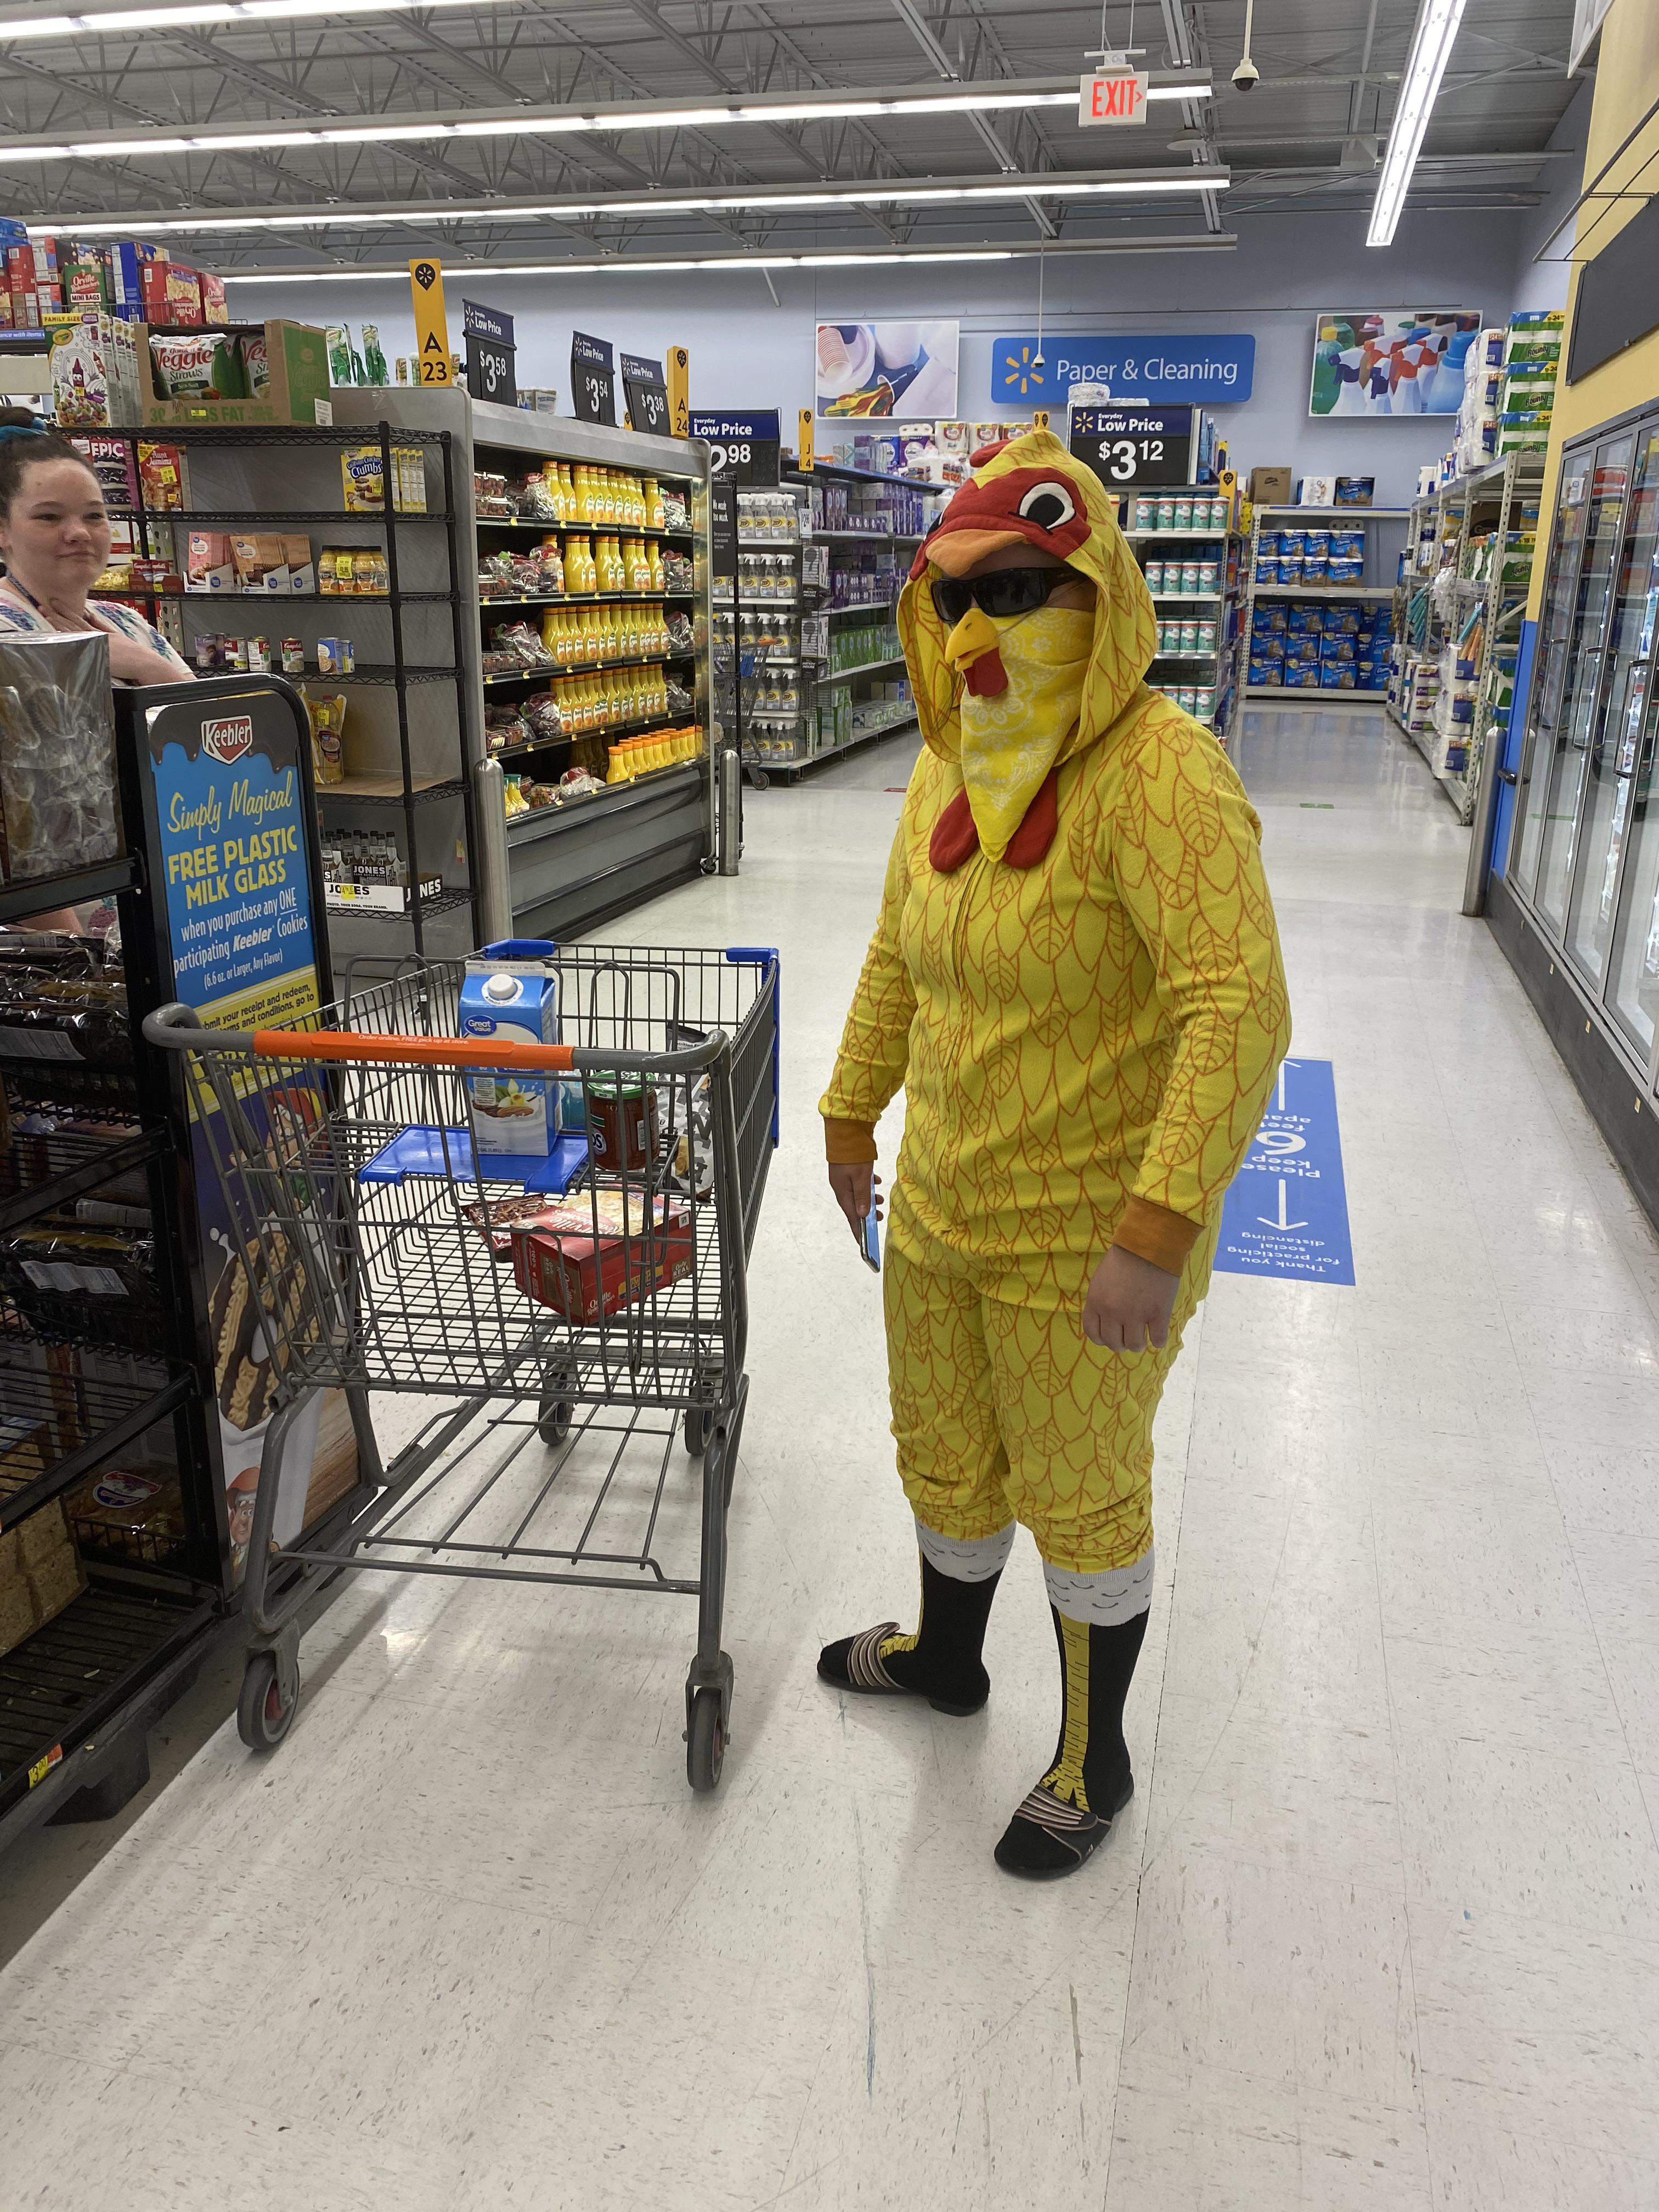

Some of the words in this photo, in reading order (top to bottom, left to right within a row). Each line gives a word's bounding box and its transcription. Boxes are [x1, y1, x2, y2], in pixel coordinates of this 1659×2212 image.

[1092, 80, 1137, 117] EXIT
[73, 274, 95, 285] Orville
[475, 316, 487, 330] Low
[488, 320, 502, 335] Price
[424, 331, 443, 353] A
[583, 345, 592, 358] Low
[592, 348, 604, 362] Price
[1527, 346, 1549, 357] Bounty
[155, 347, 215, 373] Veggie
[170, 369, 203, 382] Straws
[422, 361, 447, 381] 23
[631, 365, 642, 376] Low
[641, 368, 653, 379] Price
[1057, 360, 1117, 383] Paper
[1122, 360, 1138, 380] &
[1144, 358, 1238, 385] Cleaning
[678, 397, 686, 413] A
[1526, 395, 1547, 407] Bounty
[222, 407, 245, 422] FAT
[676, 417, 689, 432] 24
[693, 424, 719, 436] Low
[721, 422, 753, 436] Price
[1098, 421, 1126, 432] Low
[1129, 420, 1164, 432] Price
[91, 442, 124, 457] EPIC
[806, 443, 810, 454] J
[347, 459, 364, 468] Graham
[351, 463, 381, 478] Crumbs
[805, 458, 811, 468] 4
[205, 723, 251, 752] Keebler
[167, 786, 222, 840] Simply
[228, 770, 293, 825] Magical
[168, 844, 219, 885] FREE
[223, 825, 297, 869] PLASTIC
[353, 866, 386, 874] JONES
[185, 873, 230, 910] MILK
[234, 859, 286, 894] GLASS
[329, 884, 370, 895] JOES
[406, 878, 441, 902] JNES
[181, 918, 206, 942] when
[207, 917, 223, 938] you
[225, 902, 262, 932] purchase
[263, 897, 278, 916] any
[279, 887, 297, 910] ONE
[173, 940, 230, 979] participating
[233, 927, 273, 952] Keebler
[276, 913, 308, 938] Cookies
[204, 971, 217, 991] (6.6
[217, 972, 226, 983] oz.
[227, 969, 233, 979] or
[233, 961, 253, 977] Larger,
[253, 957, 263, 971] Any
[264, 947, 283, 967] Flavor)
[202, 1017, 221, 1030] bmit
[223, 1008, 239, 1025] your
[241, 999, 265, 1015] receipt
[267, 994, 280, 1006] and
[283, 984, 311, 1000] redeem,
[242, 1015, 256, 1028] and
[258, 1003, 294, 1022] conditions,
[296, 998, 305, 1008] go
[307, 992, 314, 1002] to
[1263, 1114, 1312, 1124] apar
[1260, 1122, 1305, 1132] feet
[1256, 1131, 1306, 1155] 6
[1251, 1155, 1310, 1169] keep
[1241, 1163, 1321, 1178] Please
[1242, 1232, 1325, 1246] distancing
[1227, 1246, 1310, 1261] practicing
[1260, 1243, 1306, 1252] social
[673, 1266, 690, 1277] REAL
[675, 1261, 686, 1271] Only
[1276, 1261, 1327, 1272] Thank
